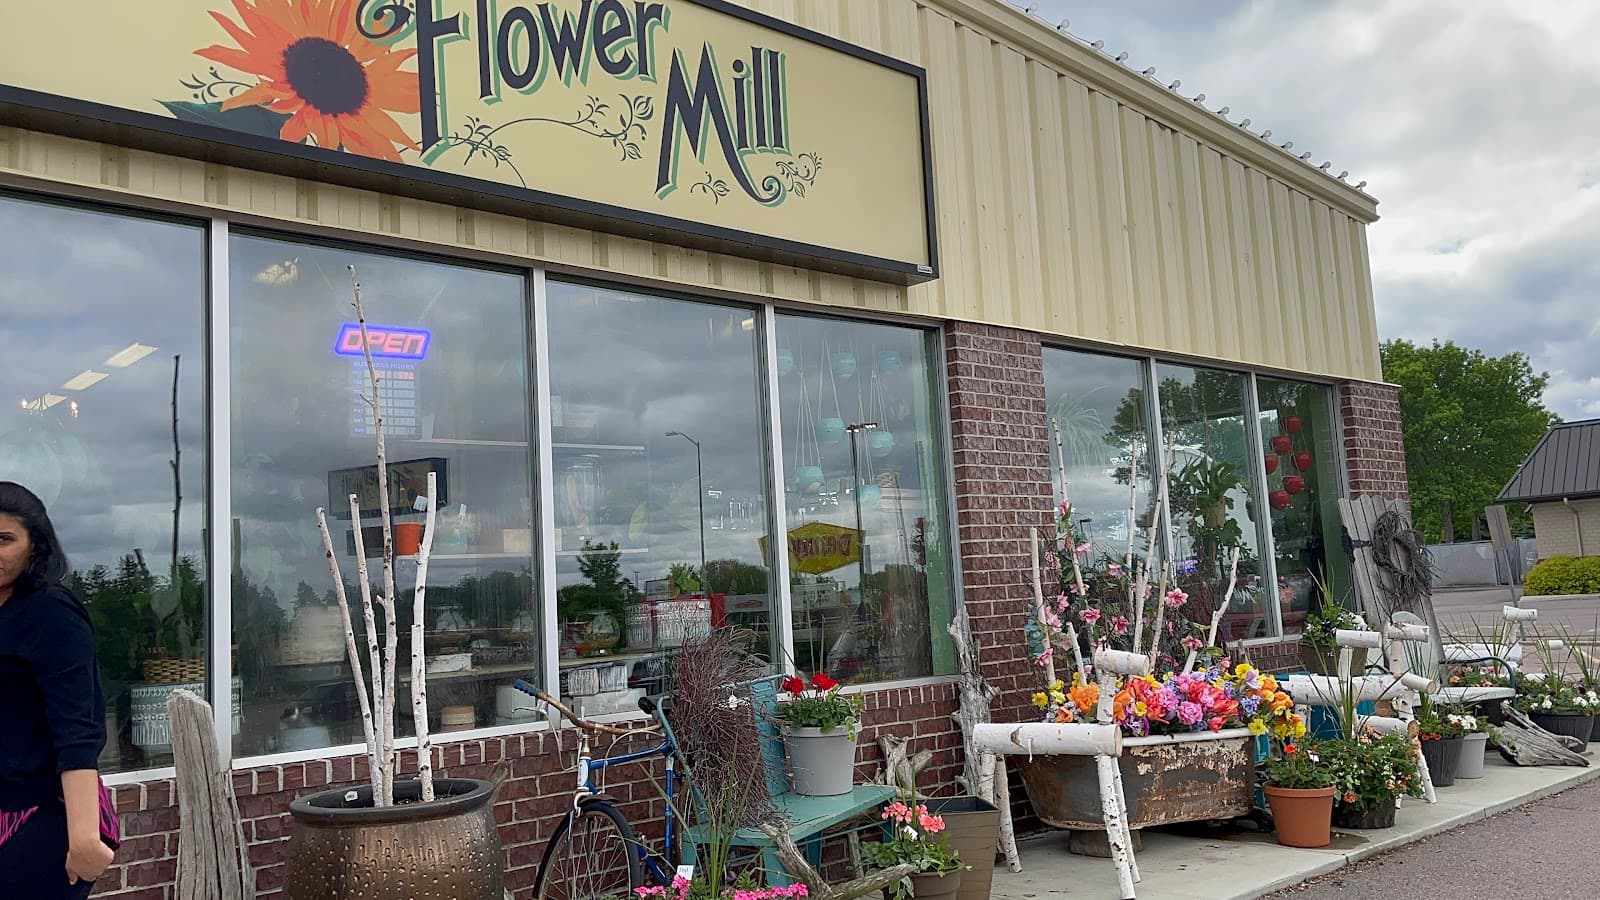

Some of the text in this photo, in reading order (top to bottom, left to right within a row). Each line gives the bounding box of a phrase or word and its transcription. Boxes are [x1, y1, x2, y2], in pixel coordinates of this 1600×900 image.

[357, 0, 667, 158] Flower
[655, 41, 788, 203] Mill
[342, 330, 426, 355] OPEN
